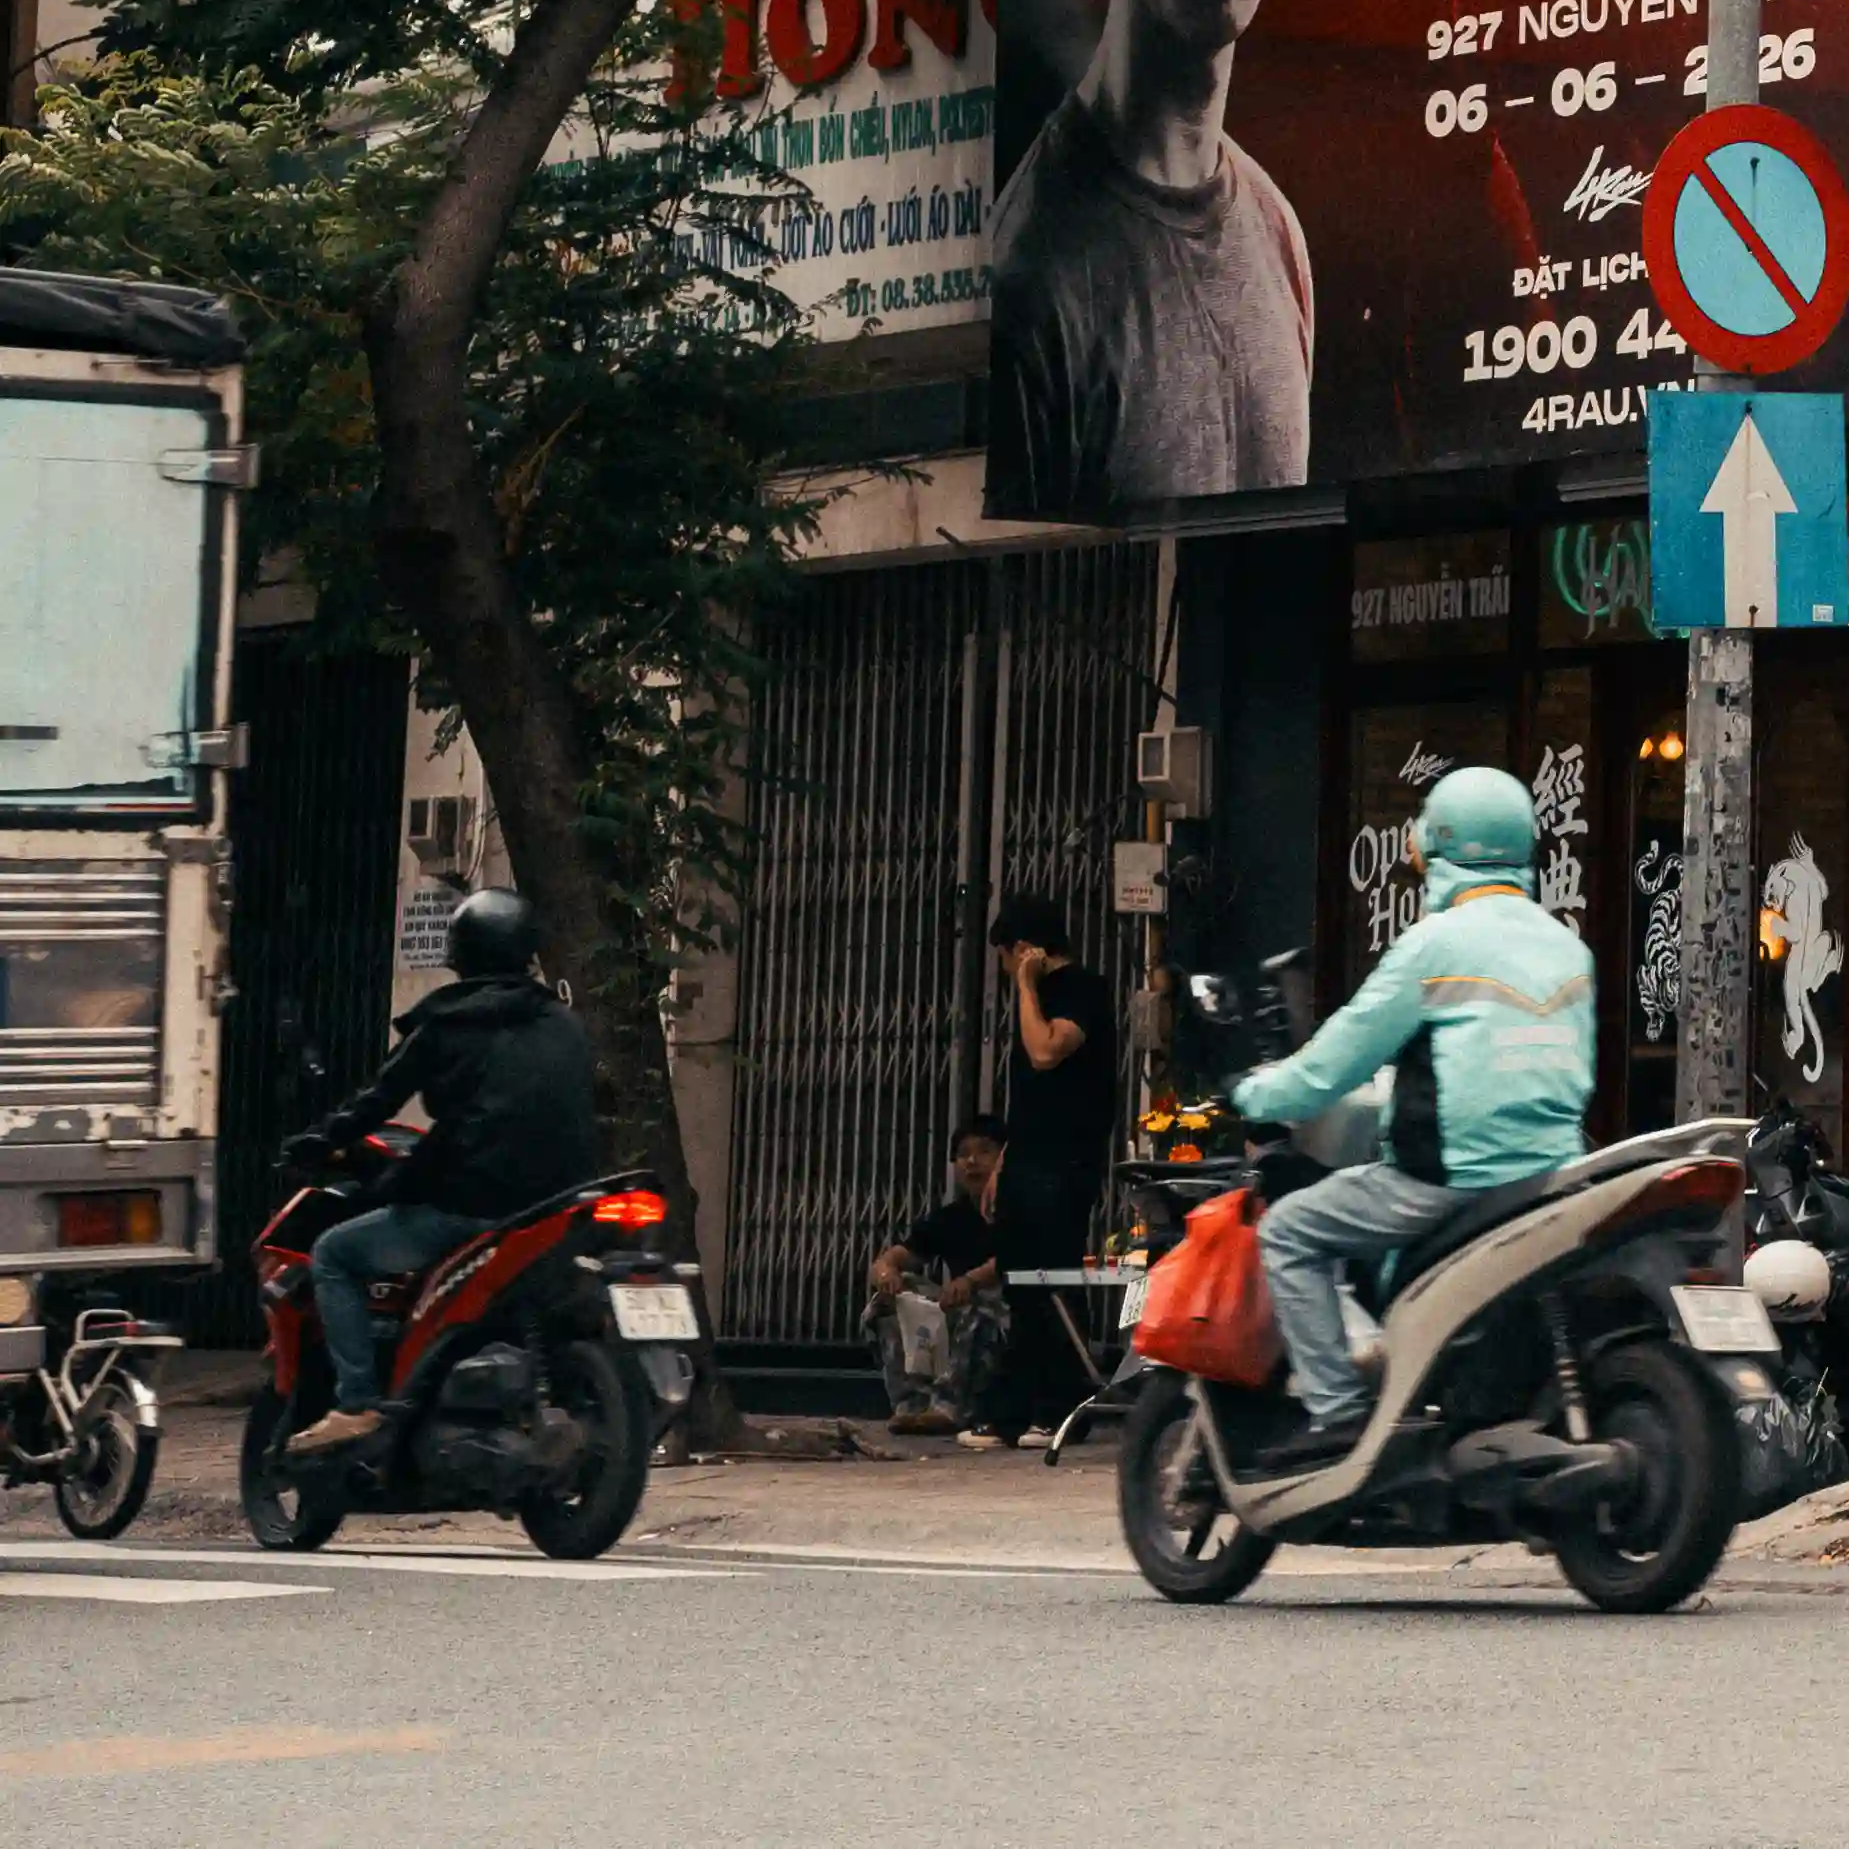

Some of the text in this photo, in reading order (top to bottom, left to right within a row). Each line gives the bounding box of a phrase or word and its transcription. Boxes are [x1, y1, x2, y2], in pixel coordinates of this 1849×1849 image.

[1427, 11, 1503, 61] 927
[1425, 84, 1488, 138] 06
[1551, 62, 1617, 117] 06
[1683, 27, 1816, 97] 226
[1513, 250, 1651, 300] ĐẶT LỊCH
[1463, 315, 1598, 383] 1900
[1351, 561, 1511, 629] 927 NGUYỄN TRÃI
[1348, 817, 1414, 893] Ope
